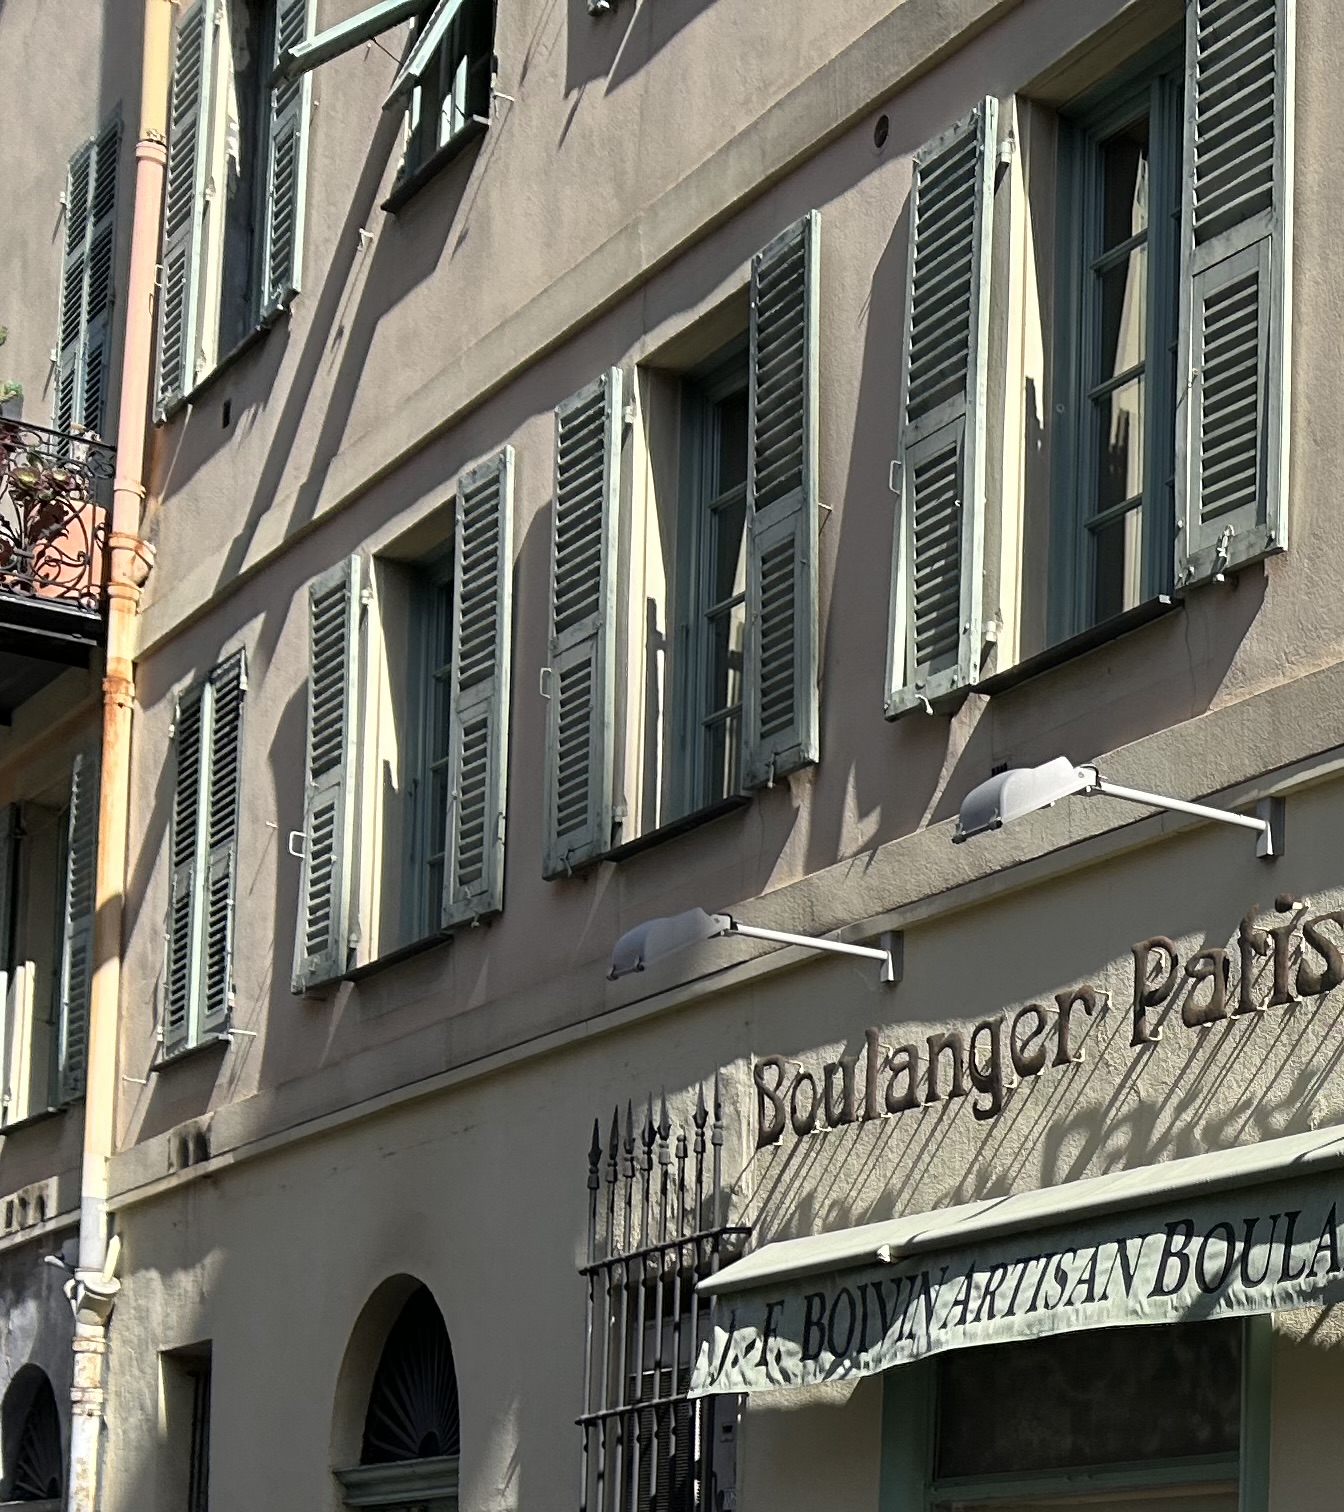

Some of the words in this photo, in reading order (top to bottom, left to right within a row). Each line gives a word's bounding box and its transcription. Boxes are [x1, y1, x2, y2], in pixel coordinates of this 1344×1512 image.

[753, 984, 1098, 1150] Boulanger
[799, 1263, 950, 1362] BOIVIN
[938, 1234, 1148, 1329] ARTISAN
